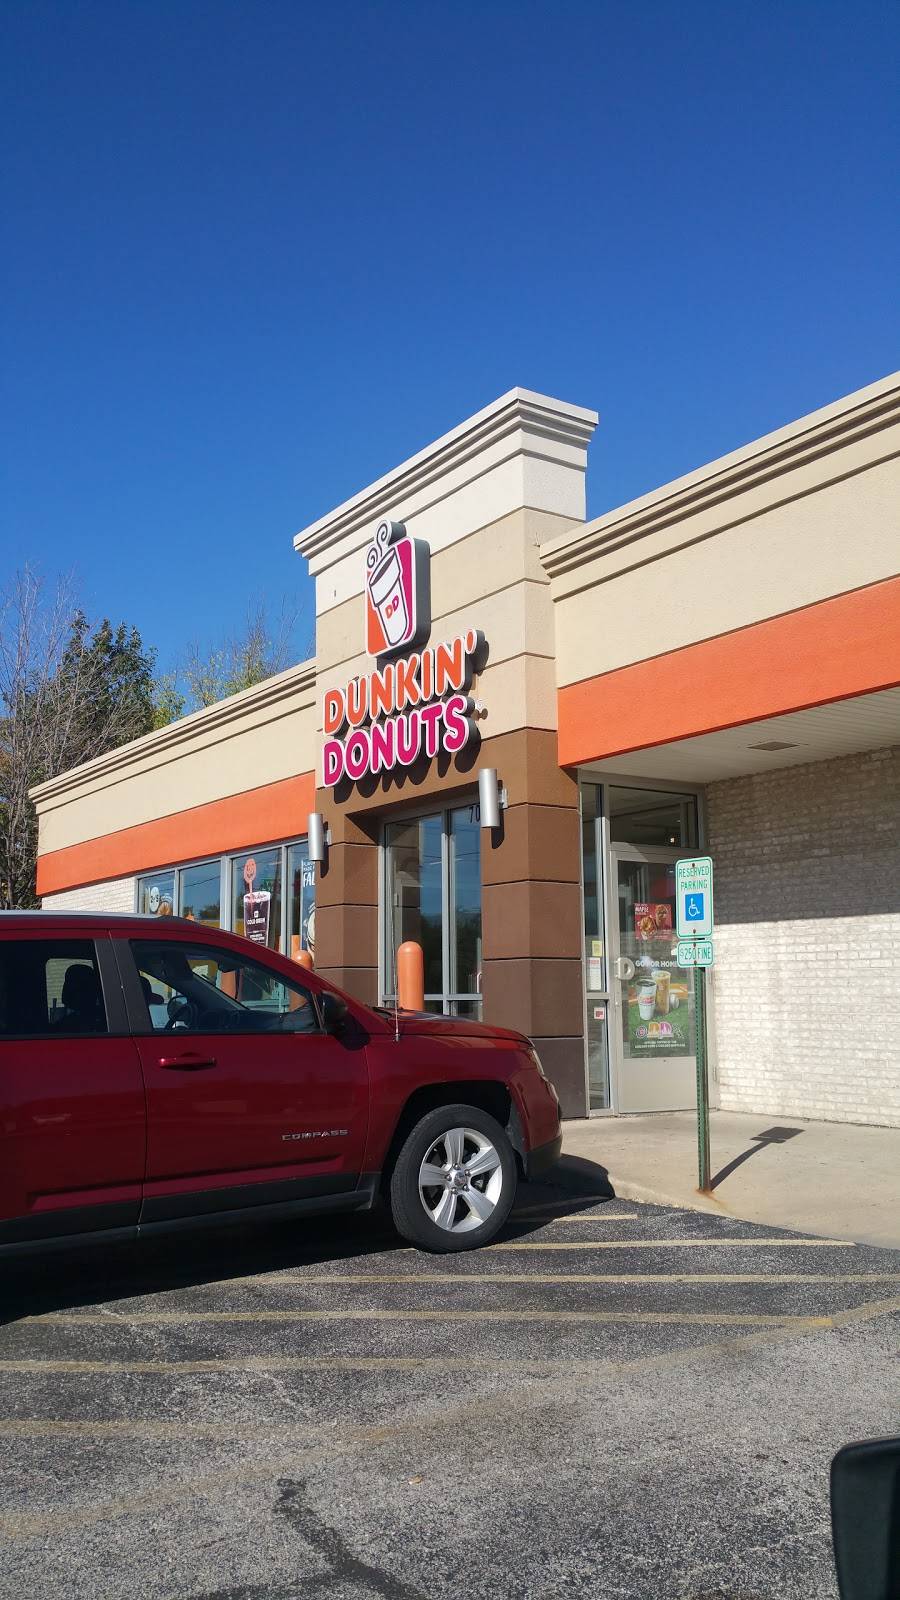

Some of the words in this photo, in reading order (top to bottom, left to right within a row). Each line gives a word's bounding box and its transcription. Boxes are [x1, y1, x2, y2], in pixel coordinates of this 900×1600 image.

[322, 695, 470, 788] DONUTS
[679, 866, 709, 878] RESERVED
[303, 871, 316, 888] FAL
[680, 879, 708, 890] PARKING
[680, 947, 696, 960] $250
[697, 946, 711, 960] FINE
[281, 1129, 349, 1141] COMPASS
